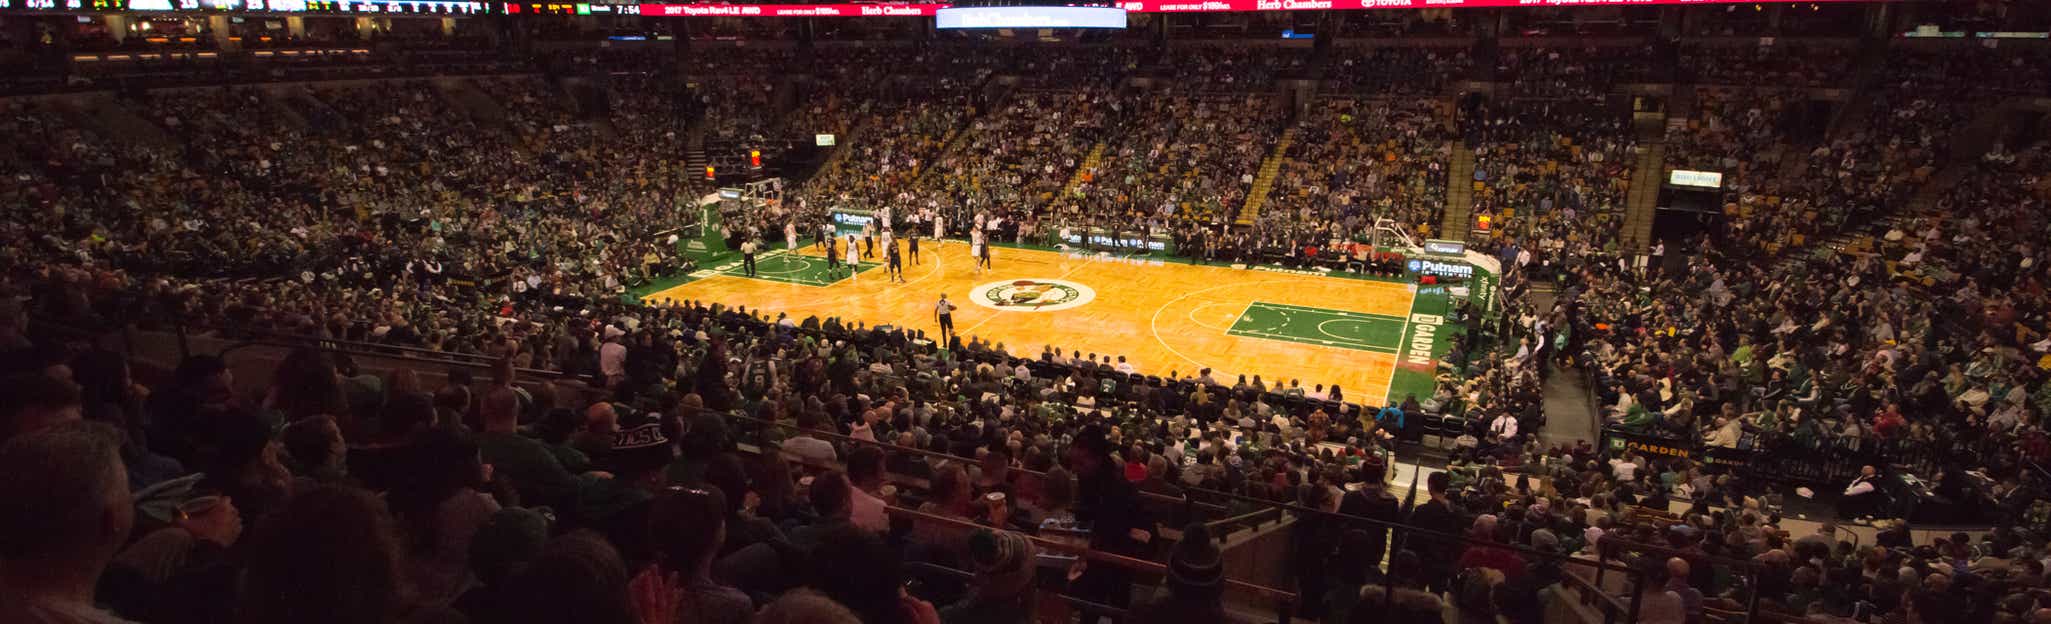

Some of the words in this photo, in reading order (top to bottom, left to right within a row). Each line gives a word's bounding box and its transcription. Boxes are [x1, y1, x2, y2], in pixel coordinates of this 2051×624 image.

[617, 5, 640, 14] 7:54
[1124, 1, 1143, 11] AWD
[1257, 0, 1281, 10] Herb
[1283, 0, 1332, 9] Chambers
[665, 6, 681, 14] 2017
[683, 6, 708, 15] Toyota
[729, 6, 740, 14] LE
[742, 6, 760, 14] AWD
[861, 6, 882, 15] Herb
[883, 6, 922, 15] Chambers
[842, 213, 874, 223] Putnam
[1422, 260, 1473, 274] Putnam
[1478, 276, 1489, 300] xfinity
[1408, 324, 1436, 364] GARDEN
[1614, 440, 1625, 448] TD
